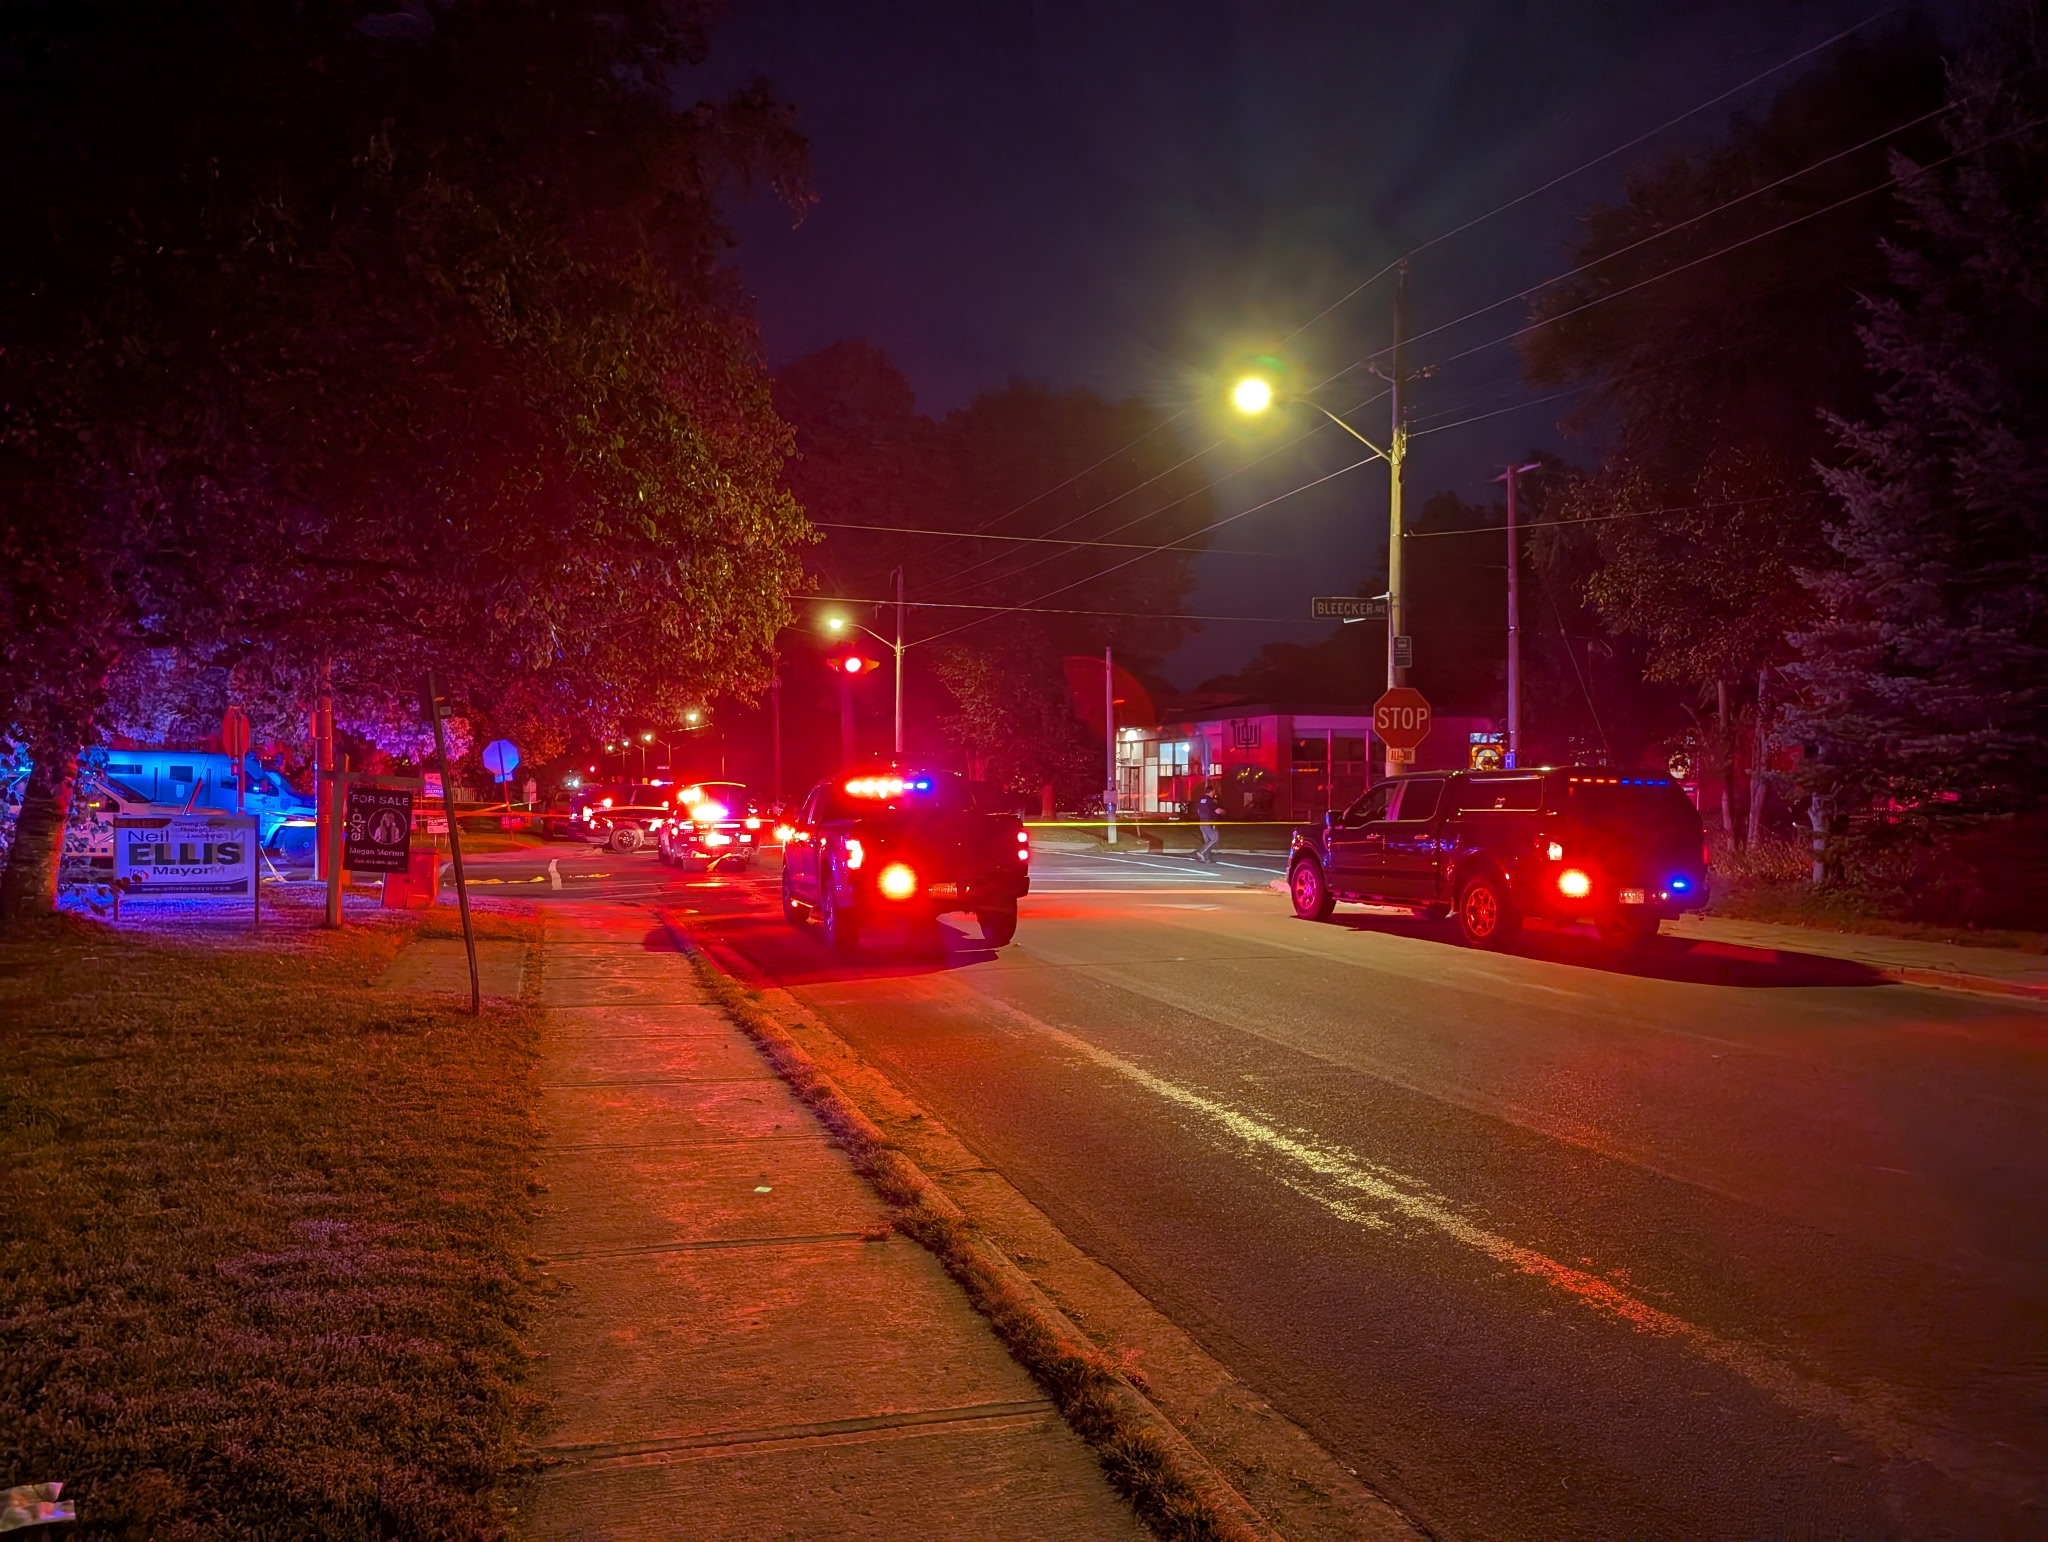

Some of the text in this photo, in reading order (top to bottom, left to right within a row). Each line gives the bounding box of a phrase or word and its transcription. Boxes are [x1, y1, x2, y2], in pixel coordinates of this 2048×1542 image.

[1317, 602, 1373, 615] BLEECKER
[1377, 706, 1428, 730] STOP
[352, 794, 409, 806] FOR SALE
[128, 830, 169, 843] Neil
[129, 842, 241, 866] ELLIS
[152, 866, 212, 877] Mayor
